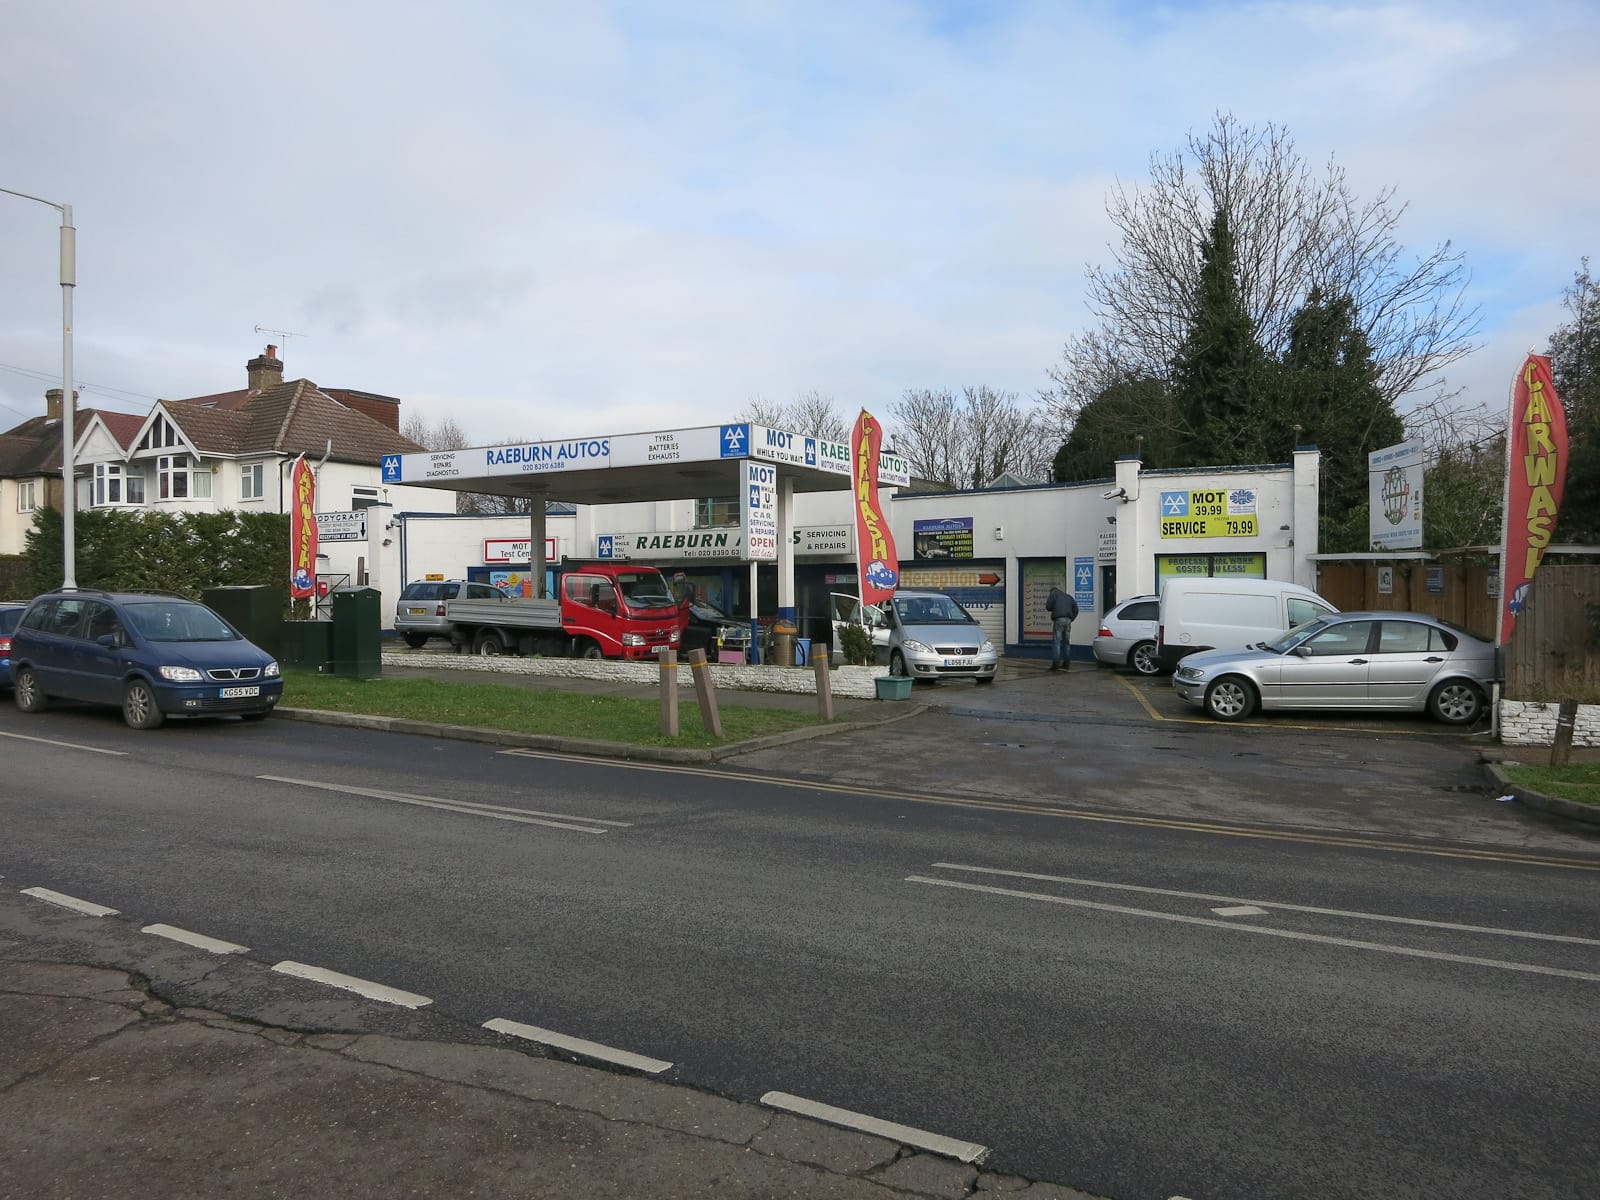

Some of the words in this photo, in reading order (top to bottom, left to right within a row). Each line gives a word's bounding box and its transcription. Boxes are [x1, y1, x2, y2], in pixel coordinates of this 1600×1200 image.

[767, 429, 793, 449] MOT
[486, 445, 552, 465] RAEBURN
[557, 440, 610, 460] AUTOS
[648, 443, 679, 452] BATTERIES
[820, 441, 850, 462] RAEB
[648, 452, 680, 460] EXHAUSTS
[757, 448, 775, 458] WHILE
[776, 450, 789, 460] YOU
[790, 454, 804, 464] WAIT
[534, 462, 549, 470] 8390
[1522, 362, 1558, 579] CARWASH
[426, 469, 460, 477] DIAGNOSTICS
[750, 466, 774, 484] MOT
[857, 411, 889, 561] CARWASH
[765, 494, 770, 504] U
[1192, 492, 1225, 504] MOT
[1195, 506, 1222, 516] 39.99
[315, 512, 365, 522] ODYCRAFT
[750, 519, 775, 528] SERVICING
[1162, 522, 1206, 535] SERVICE
[1226, 520, 1253, 534] 79.99
[636, 533, 728, 550] RAEBURN
[750, 537, 774, 548] OPEN
[1168, 558, 1228, 566] PROFESSINAL
[1176, 566, 1202, 574] COSTS
[1202, 565, 1221, 573] YU
[903, 568, 976, 590] Reception
[224, 688, 243, 696] KG55
